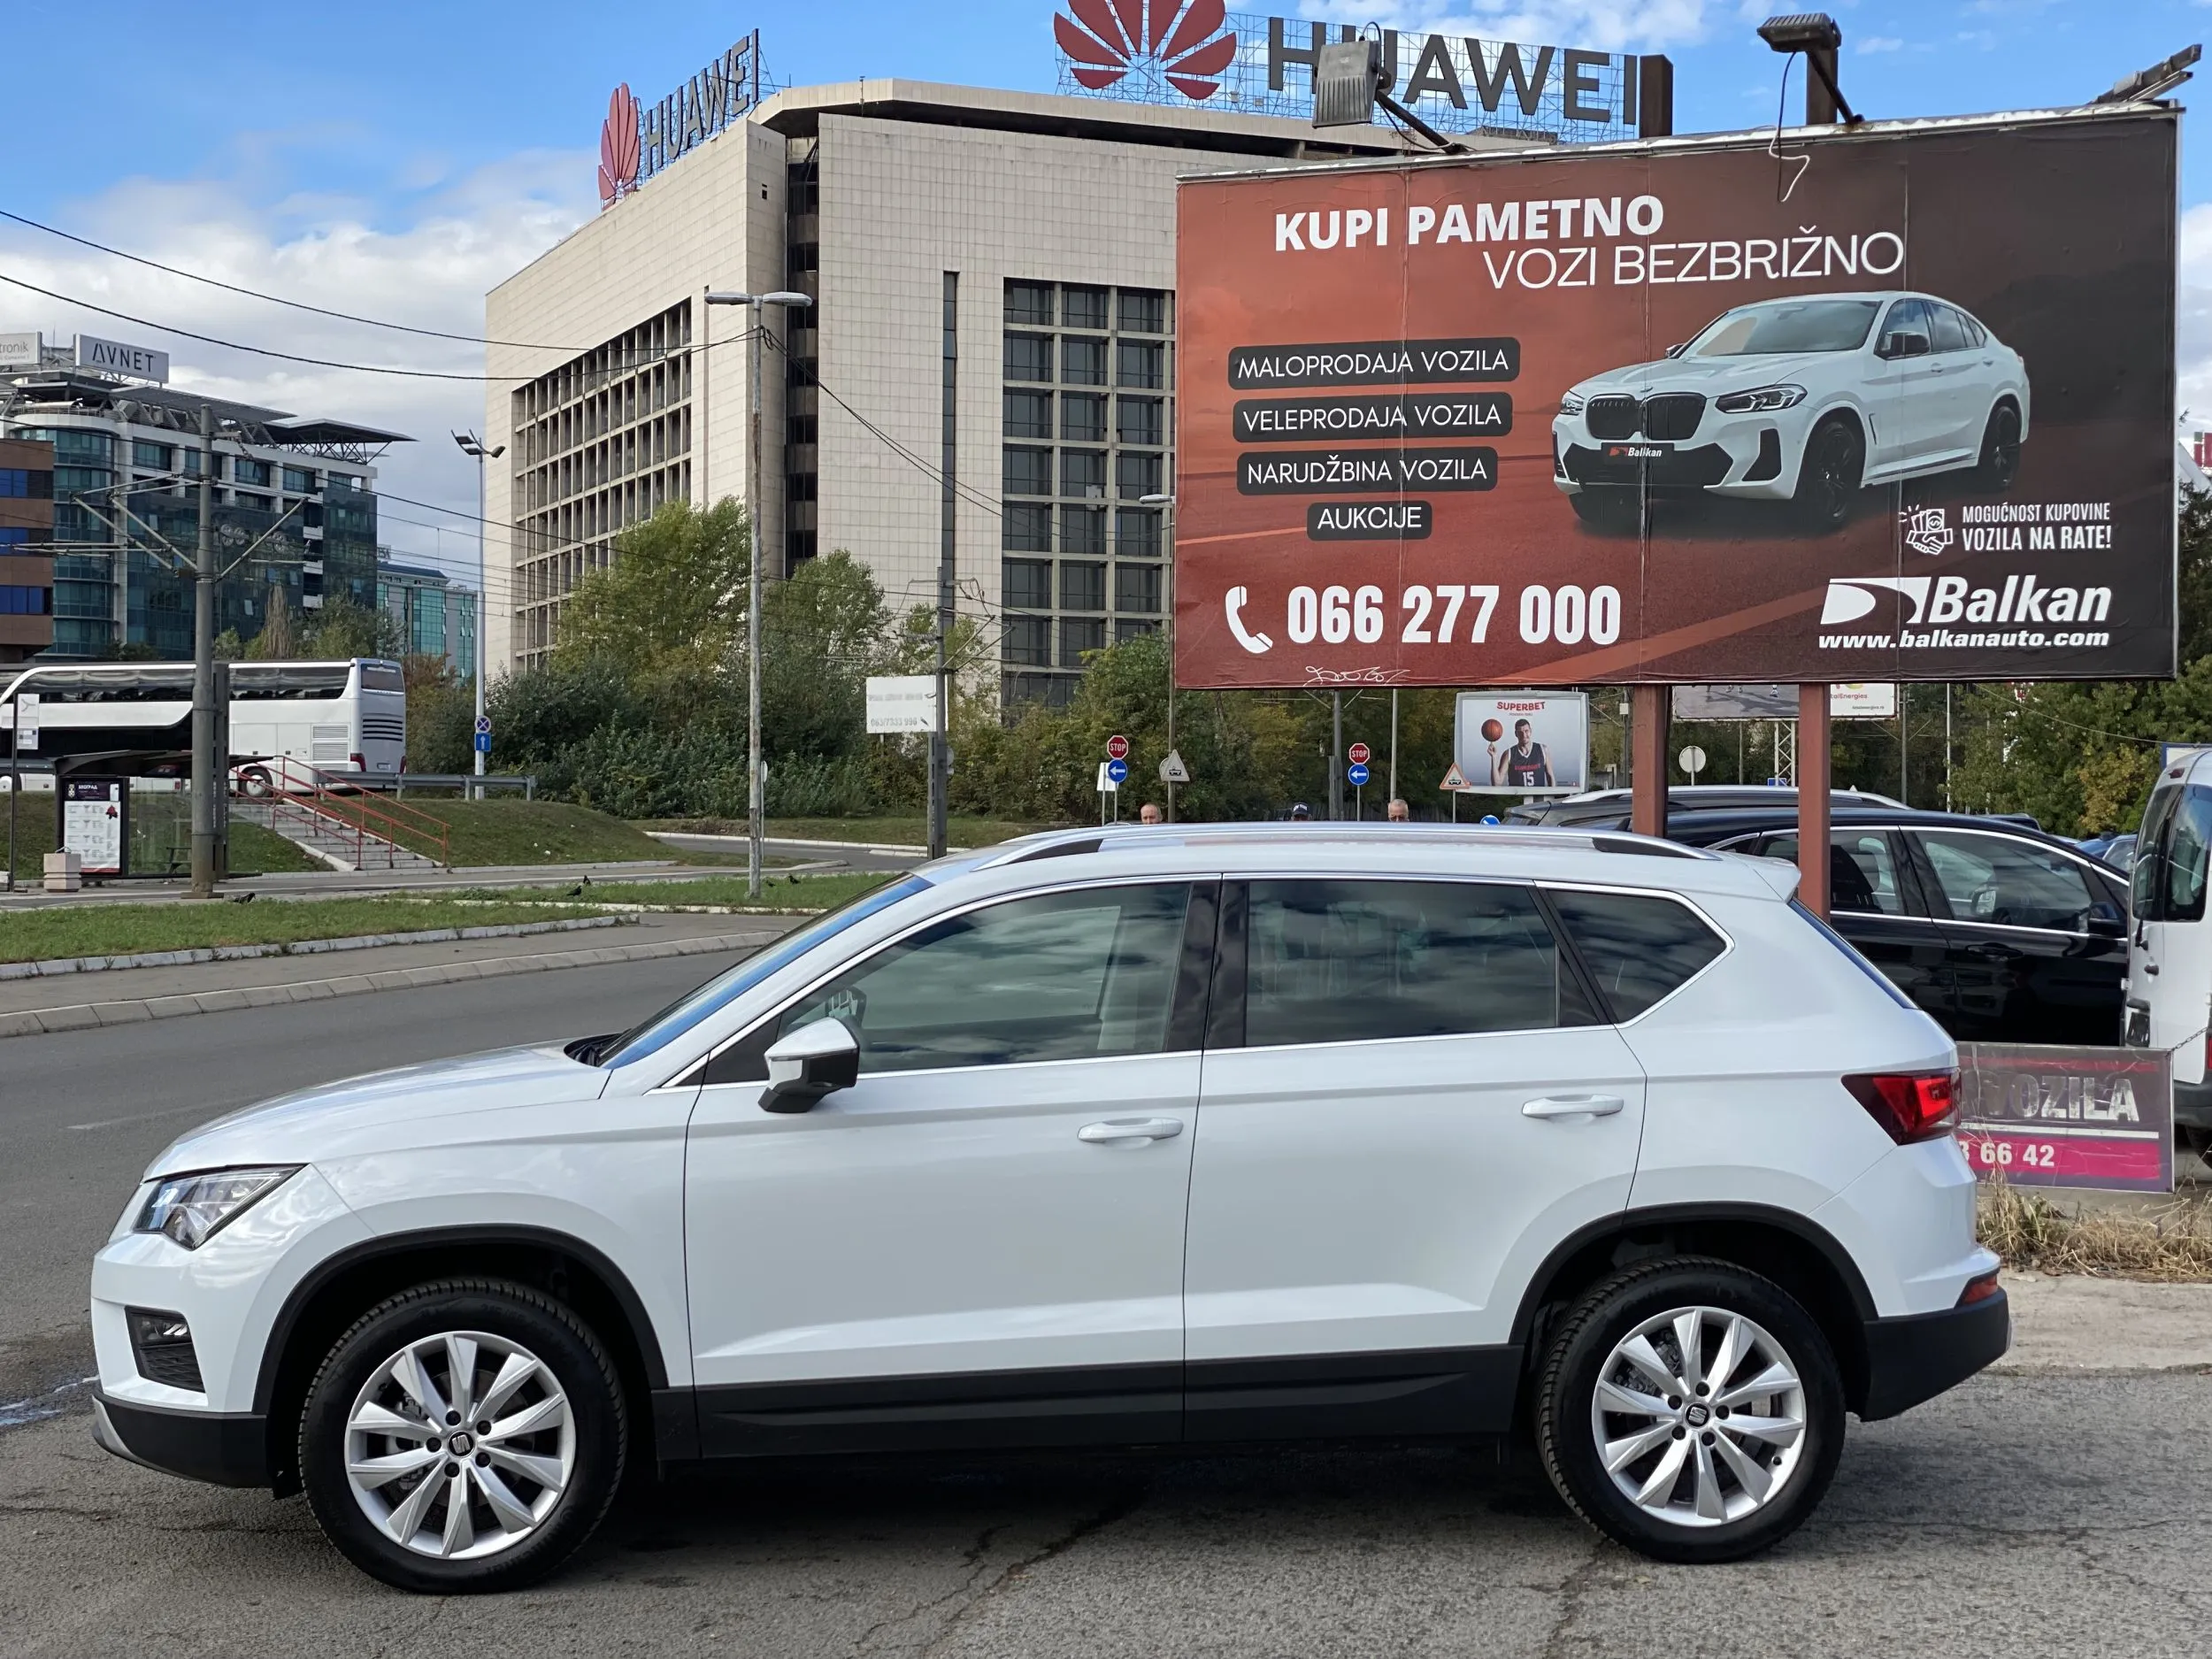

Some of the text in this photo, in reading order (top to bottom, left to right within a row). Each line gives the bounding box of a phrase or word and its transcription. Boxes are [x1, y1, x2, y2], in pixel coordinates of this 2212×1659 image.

[645, 28, 759, 176] HUAWEI
[1275, 195, 1664, 251] KUPI PAMETNO
[1482, 225, 1905, 289] VOZI BEZBRIŽNO
[92, 342, 154, 373] AVNET
[1238, 349, 1509, 379] MALOPRODAJA VOZILA
[1243, 403, 1502, 432] VELEPRODAJA VOZILA
[1628, 447, 1663, 457] Balkan
[1248, 454, 1487, 485] NARUDŽBINA VOZILA
[1317, 506, 1422, 530] AUKCIJE
[1962, 502, 2111, 524] MOGUĆNOST KUPOVINE
[1962, 526, 2112, 552] VOZILA NA RATE!
[1928, 574, 2112, 624] Balkan
[1287, 584, 1621, 645] 066 277 000
[1818, 630, 2110, 649] www.balkanauto.com
[1496, 701, 1546, 711] SUPERBET
[1110, 743, 1126, 752] STOP
[1351, 749, 1367, 758] STOP
[1522, 771, 1535, 787] 15
[1982, 1071, 2140, 1123] VOZILA
[1980, 1141, 2013, 1165] 66
[2022, 1144, 2055, 1167] 42
